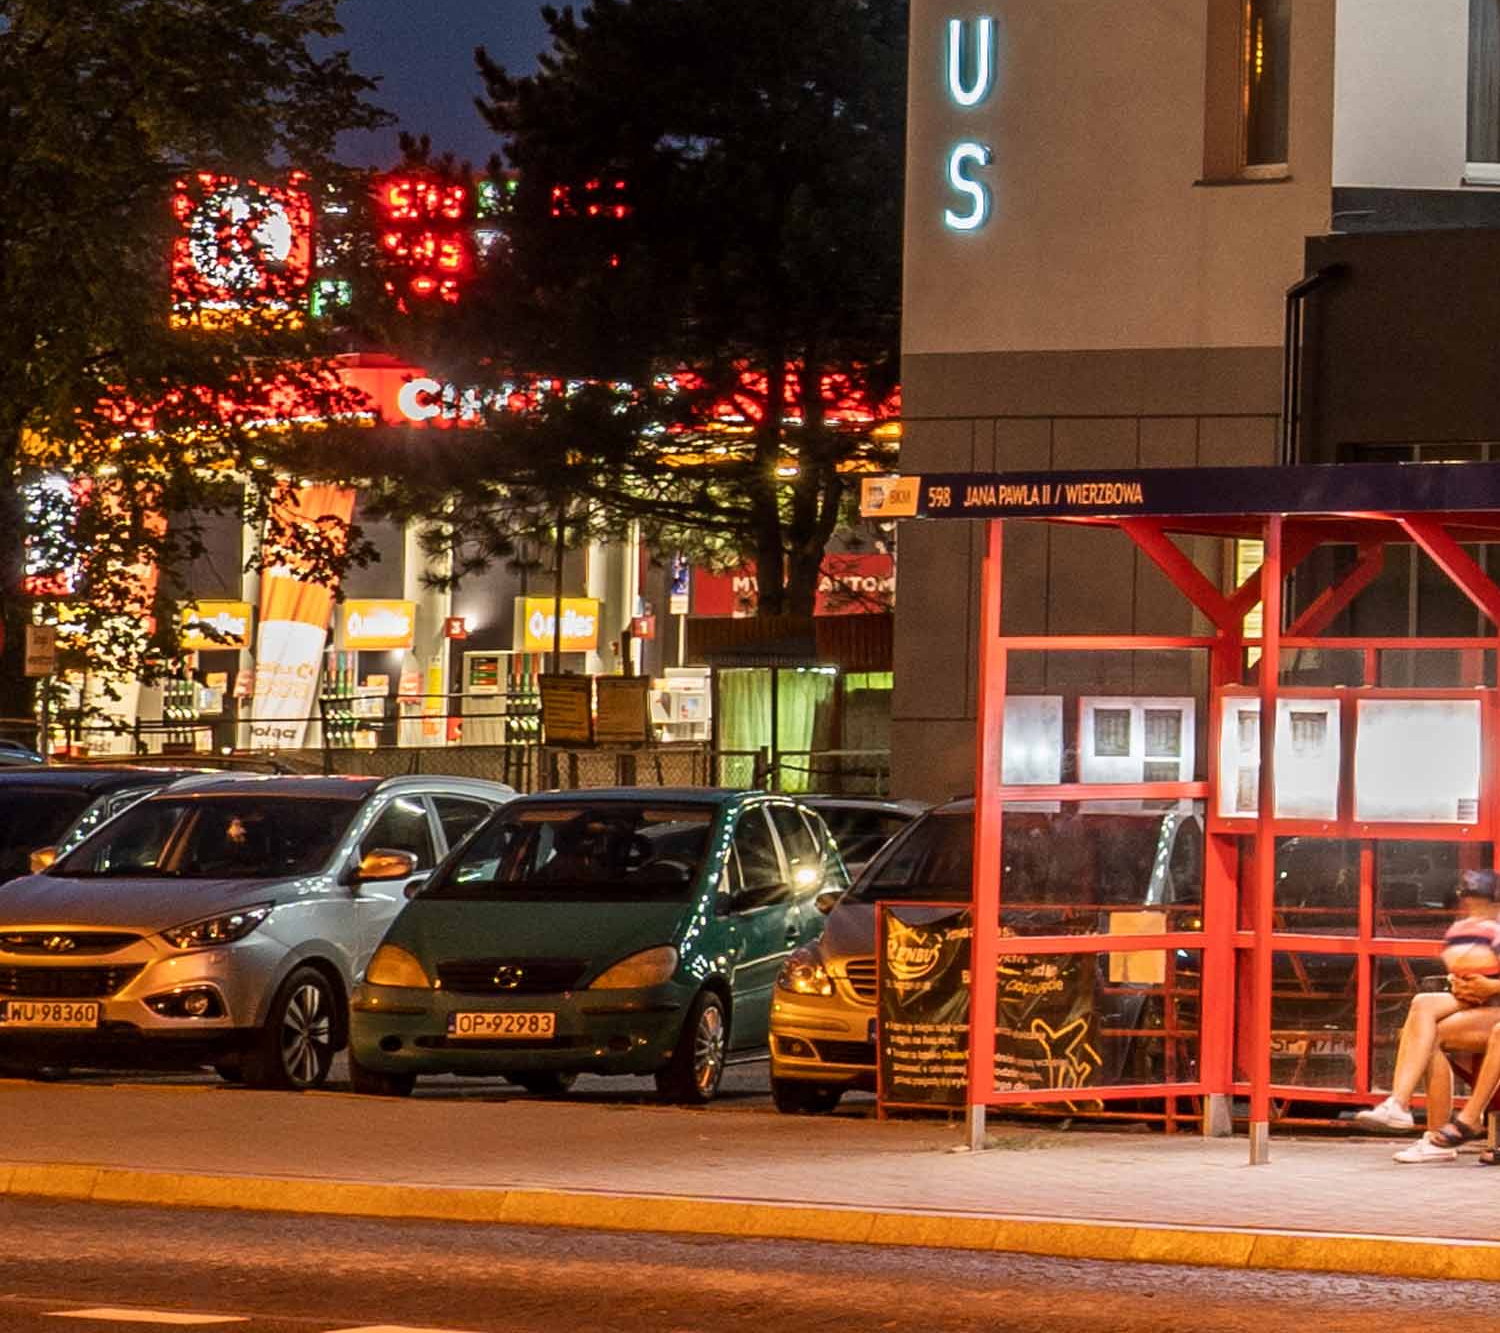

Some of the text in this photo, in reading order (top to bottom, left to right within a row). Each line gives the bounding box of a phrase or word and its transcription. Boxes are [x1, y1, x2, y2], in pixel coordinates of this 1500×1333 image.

[928, 486, 951, 508] 598
[962, 485, 997, 507] JANA
[1065, 482, 1144, 505] WIERZBOWA
[10, 1004, 96, 1022] WU 98360
[459, 1015, 552, 1033] OP 92983
